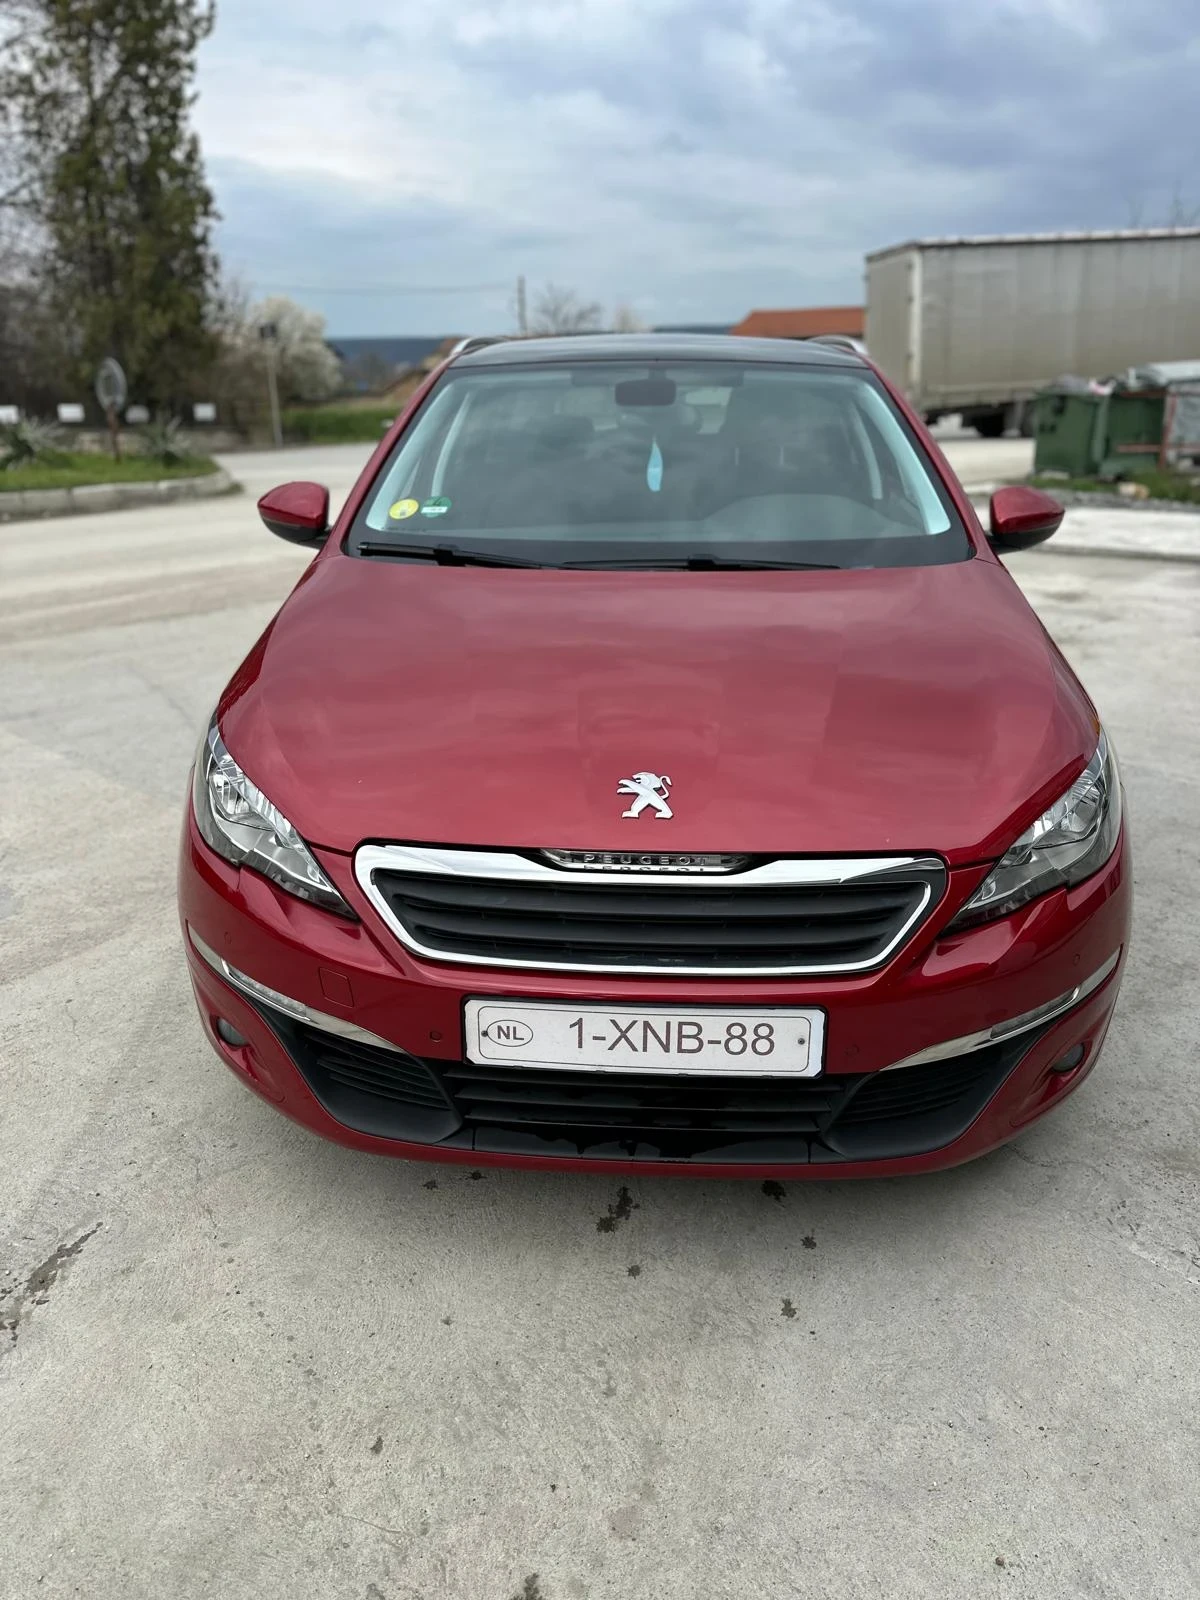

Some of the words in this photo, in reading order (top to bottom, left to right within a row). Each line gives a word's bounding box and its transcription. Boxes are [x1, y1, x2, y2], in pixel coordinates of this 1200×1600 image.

[583, 853, 709, 866] PEUGEOT
[497, 1025, 525, 1041] NL
[569, 1017, 775, 1056] 1-XNB-88
